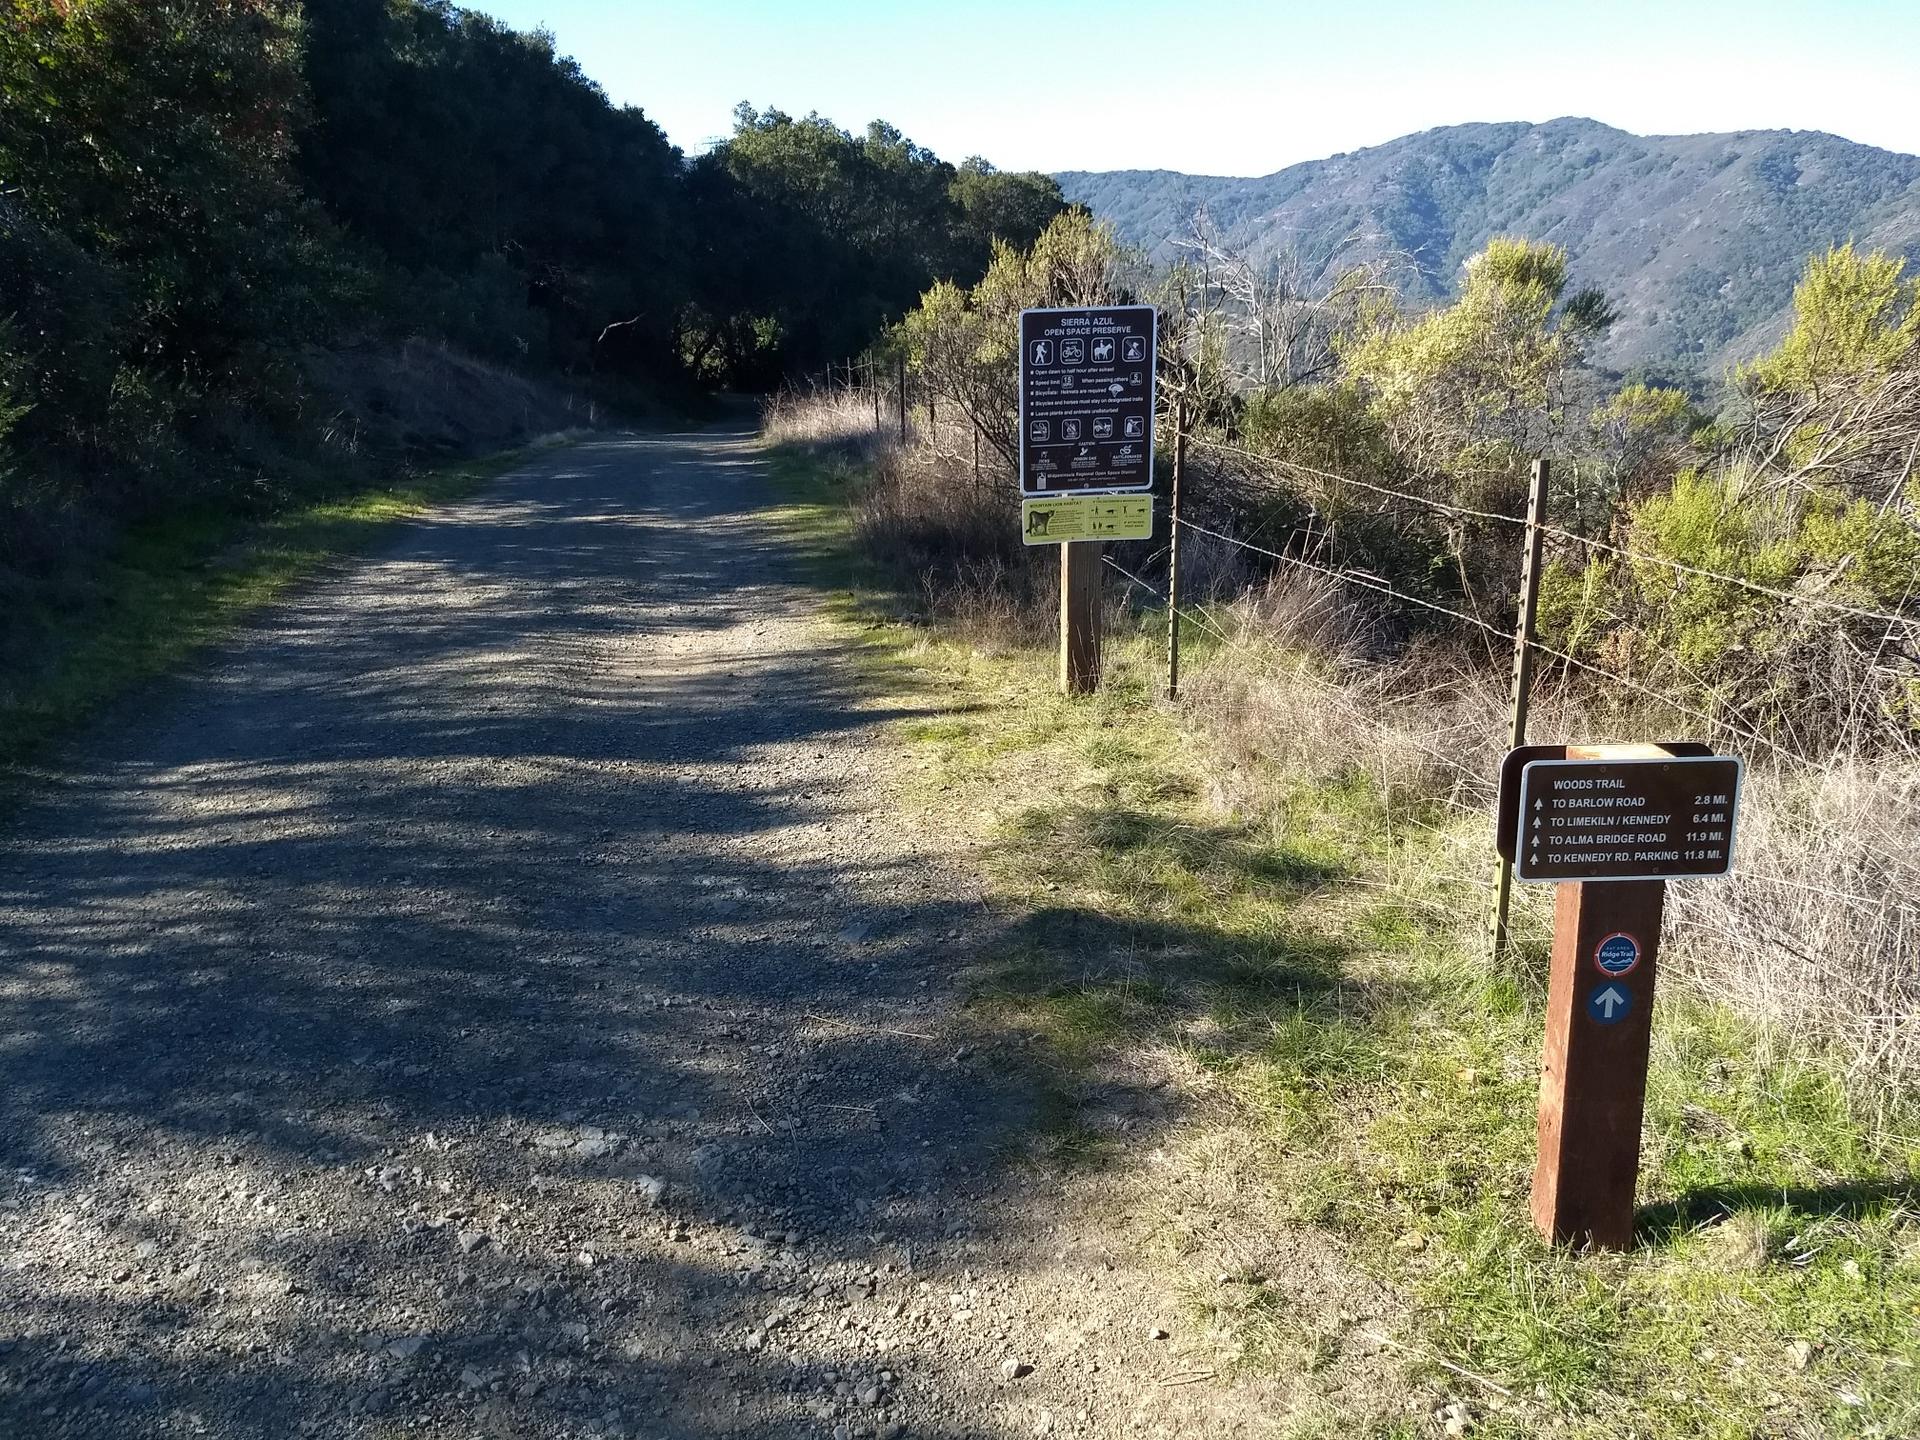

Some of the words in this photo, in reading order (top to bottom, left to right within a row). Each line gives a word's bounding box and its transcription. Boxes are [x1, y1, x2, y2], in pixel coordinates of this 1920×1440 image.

[1061, 318, 1090, 326] SIERRA
[1093, 317, 1114, 326] AZUL
[1066, 328, 1091, 336] SPACE
[1092, 326, 1132, 334] PRESERVE
[1554, 780, 1592, 790] WOODS
[1595, 780, 1624, 789] TRAIL
[1552, 799, 1566, 808] TO
[1568, 798, 1614, 808] BARLOW
[1616, 797, 1646, 806] ROAD
[1694, 795, 1710, 805] 2.8
[1712, 795, 1728, 804] MI.
[1550, 818, 1564, 827] TO
[1567, 816, 1614, 826] LIMEKILN
[1616, 816, 1620, 826] /
[1622, 814, 1671, 825] KENNEDY
[1692, 814, 1708, 824] 6.4
[1710, 814, 1726, 823] MI.
[1549, 836, 1562, 845] TO
[1564, 834, 1594, 844] ALMA
[1596, 834, 1635, 844] BRIDGE
[1637, 833, 1666, 843] ROAD
[1686, 832, 1706, 842] 11.9
[1708, 832, 1724, 840] MI.
[1548, 854, 1561, 863] TO
[1564, 852, 1612, 862] KENNEDY
[1614, 852, 1632, 862] RD.
[1634, 851, 1679, 861] PARKING
[1684, 850, 1704, 860] 11.8
[1706, 850, 1722, 859] MI.
[1602, 950, 1620, 958] Ridge
